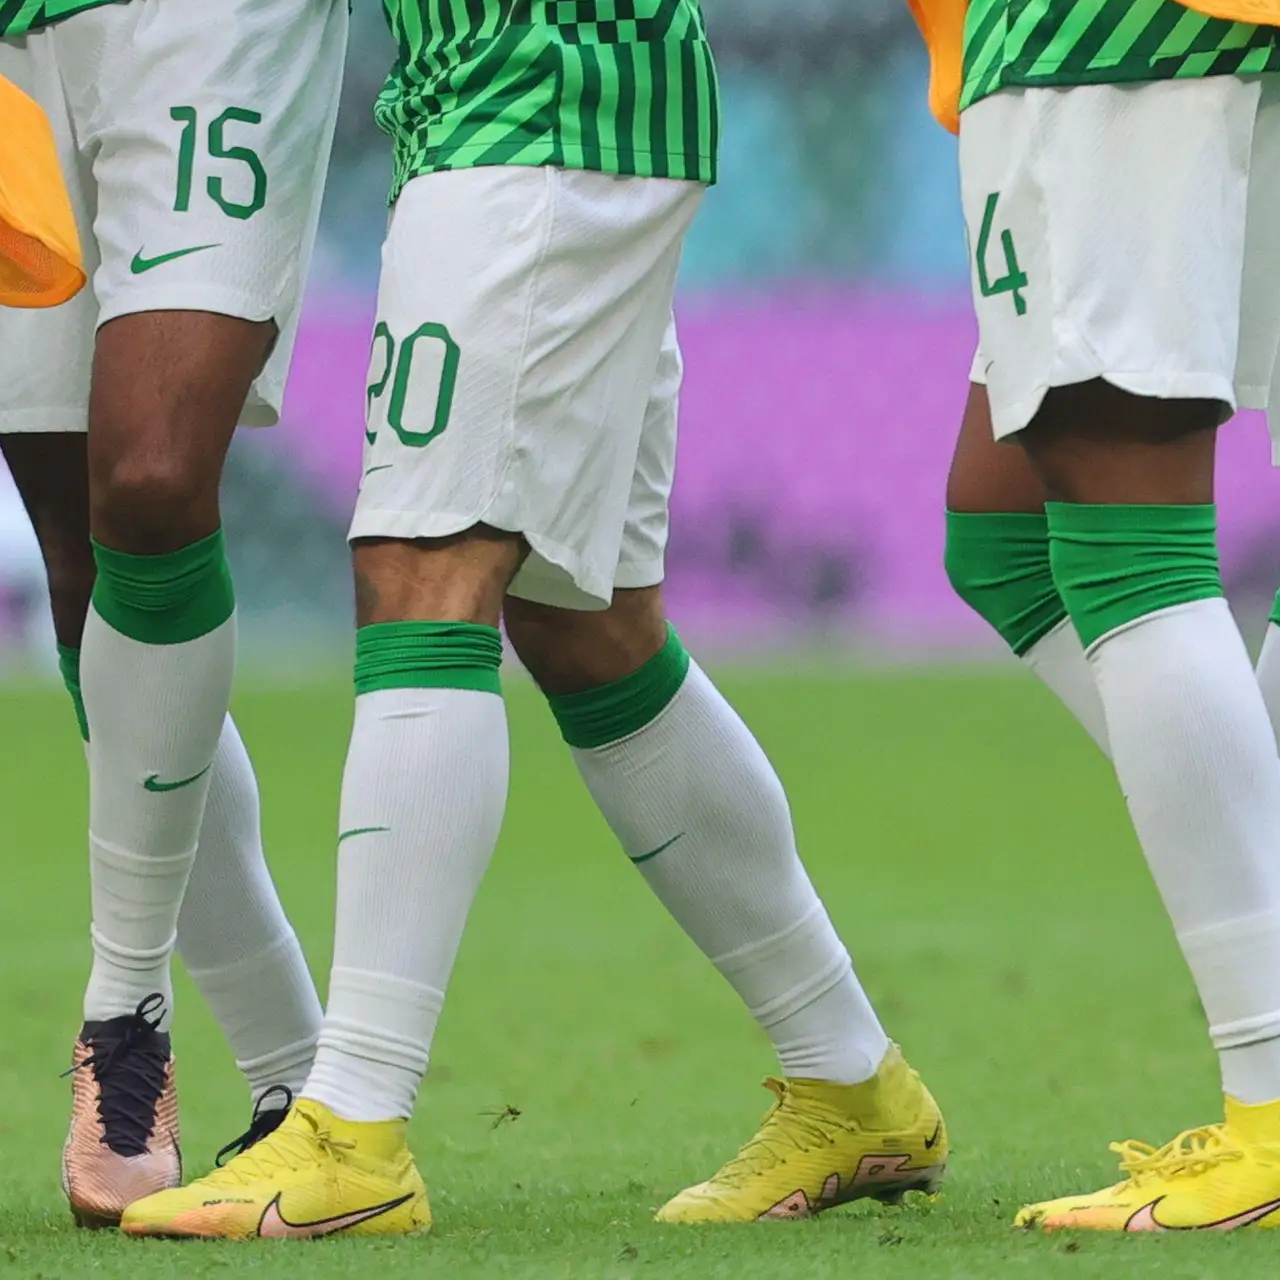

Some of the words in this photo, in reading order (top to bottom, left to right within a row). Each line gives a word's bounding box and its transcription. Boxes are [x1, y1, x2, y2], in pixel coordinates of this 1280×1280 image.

[170, 106, 267, 220] 15
[976, 191, 1028, 316] 4
[365, 322, 461, 447] 20
